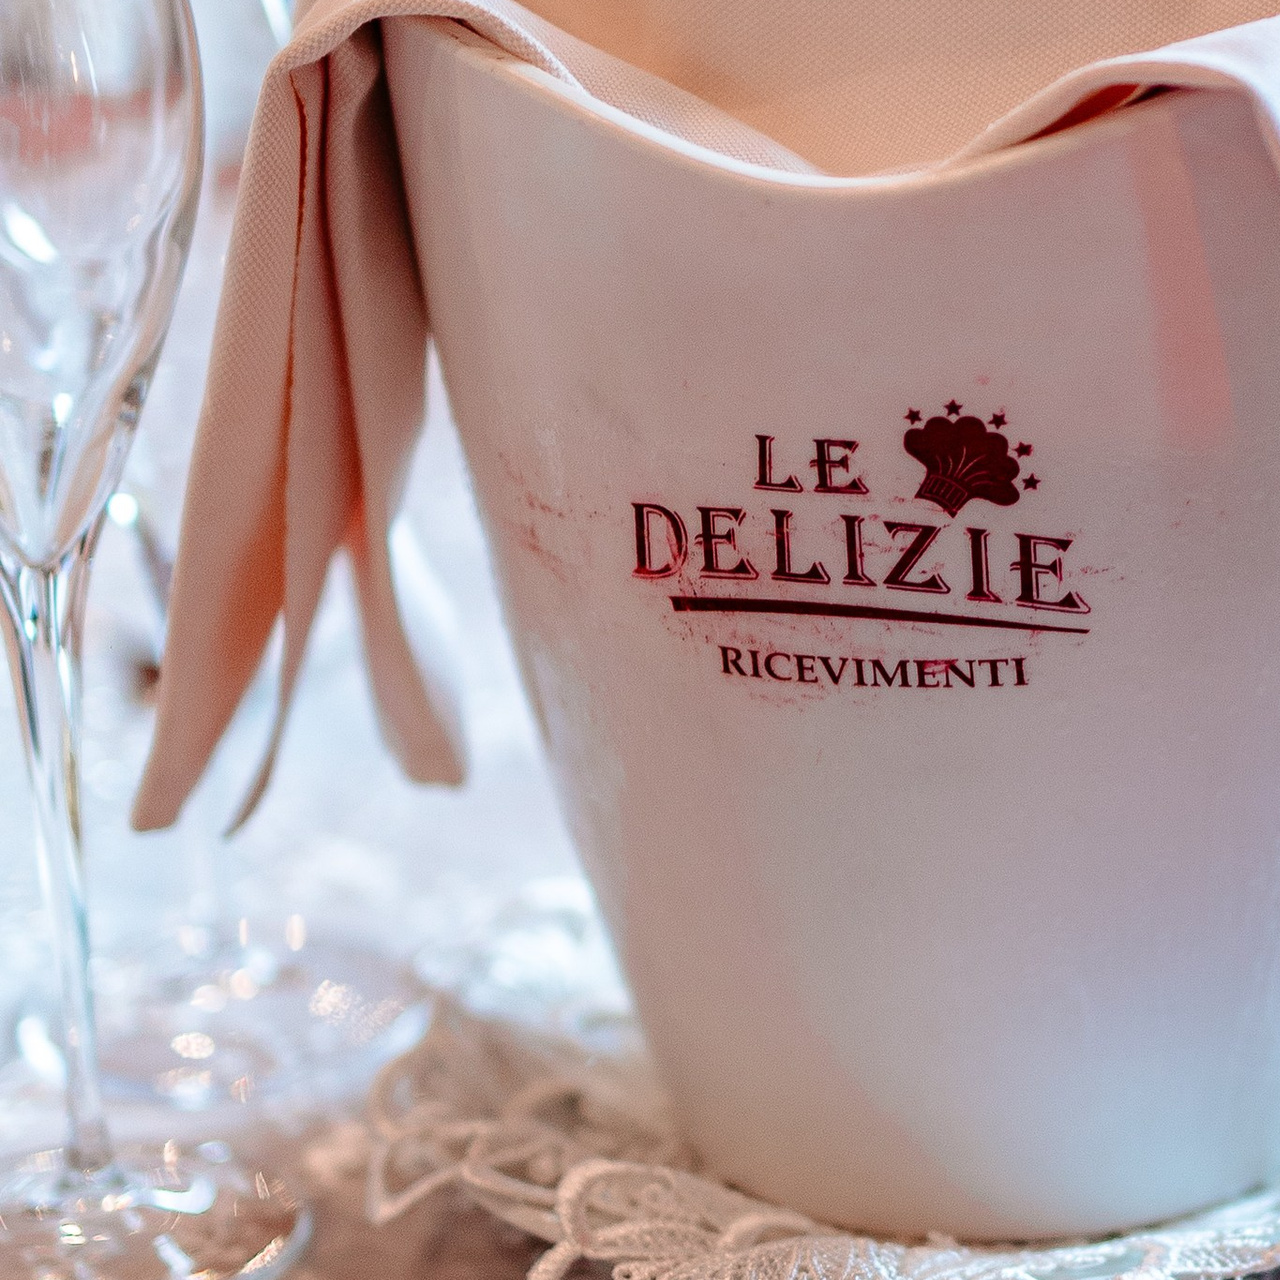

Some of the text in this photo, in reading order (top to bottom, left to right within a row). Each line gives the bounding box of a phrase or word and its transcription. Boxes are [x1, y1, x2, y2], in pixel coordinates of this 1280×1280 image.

[753, 434, 869, 494] LE
[630, 502, 1091, 614] DELIZIE
[717, 645, 1029, 689] RICEVIMENTI
